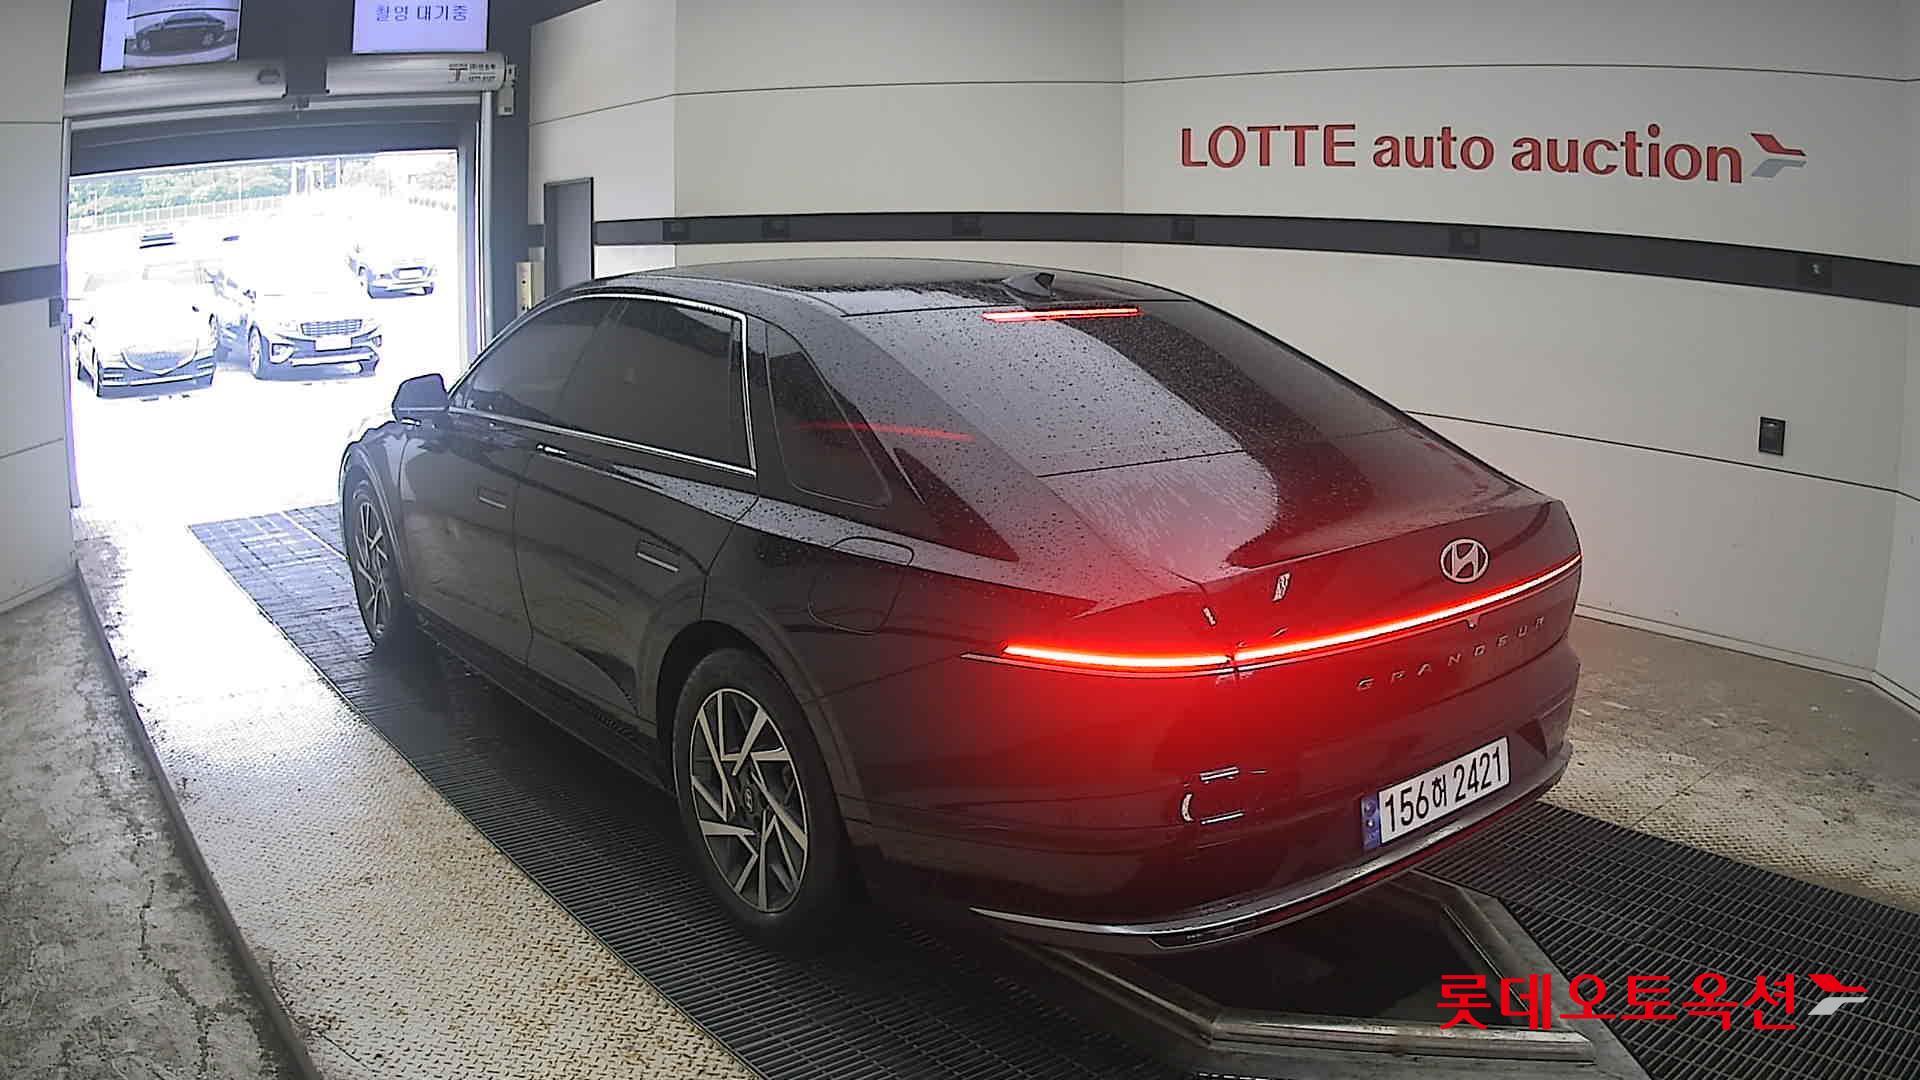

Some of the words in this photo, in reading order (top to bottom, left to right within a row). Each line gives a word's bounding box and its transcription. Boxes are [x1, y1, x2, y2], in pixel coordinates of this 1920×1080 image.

[417, 5, 467, 21] 대기중
[1182, 124, 1356, 168] LOTTE
[1372, 126, 1496, 170] auto
[1511, 123, 1743, 184] auction
[1356, 615, 1545, 692] GRANDEUR
[1385, 774, 1447, 832] 156허
[1453, 746, 1501, 802] 2421
